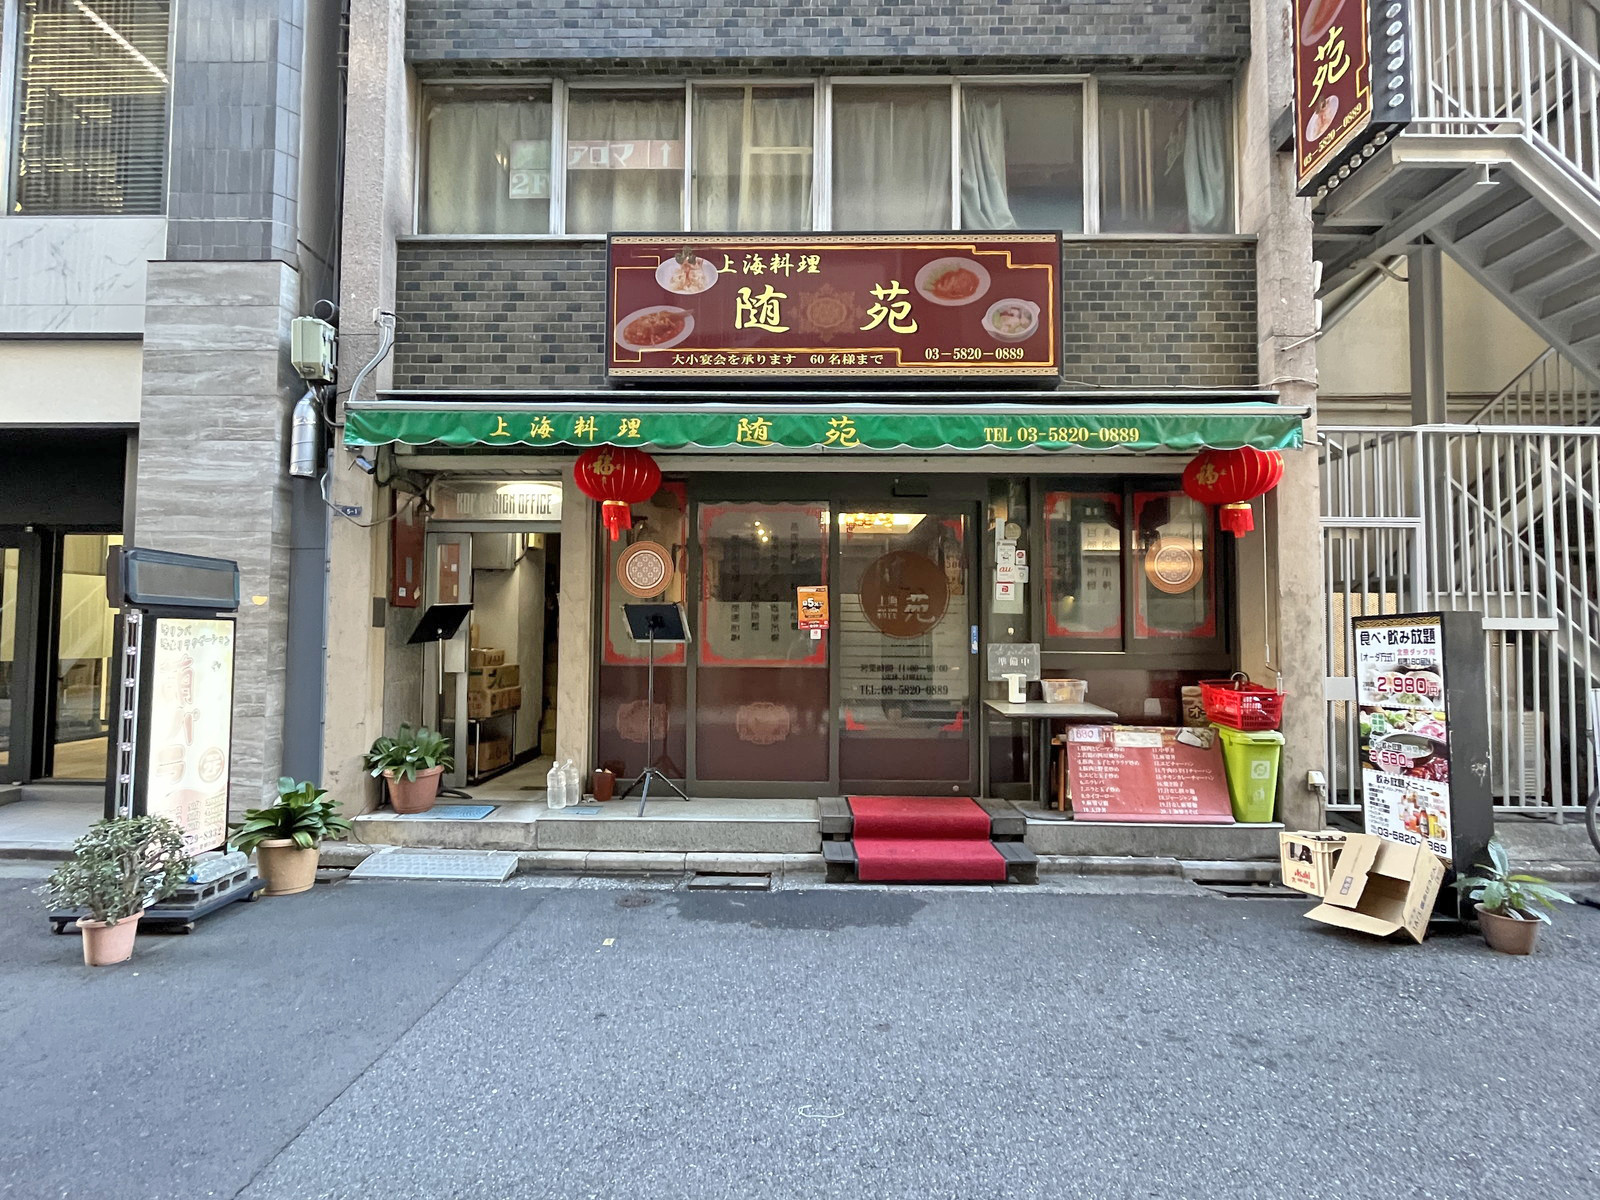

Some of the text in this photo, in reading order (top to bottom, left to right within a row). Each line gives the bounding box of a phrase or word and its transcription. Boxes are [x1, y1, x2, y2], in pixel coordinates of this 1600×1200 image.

[1308, 26, 1350, 108] 苑
[568, 144, 634, 167] アロマ
[511, 172, 549, 196] 2F
[716, 253, 822, 277] 上海料理
[672, 352, 798, 367] 大小宴会を承ります
[925, 347, 1025, 361] 03-5820-0889
[489, 415, 642, 442] 上海料理
[983, 427, 1012, 443] TEL
[1017, 427, 1140, 443] 03-5820-0889
[518, 493, 552, 514] OFFICE
[1360, 628, 1436, 646] 食べ・飲み放題
[997, 656, 1030, 667] 準備中
[1376, 774, 1434, 792] 飲み放題メニュー
